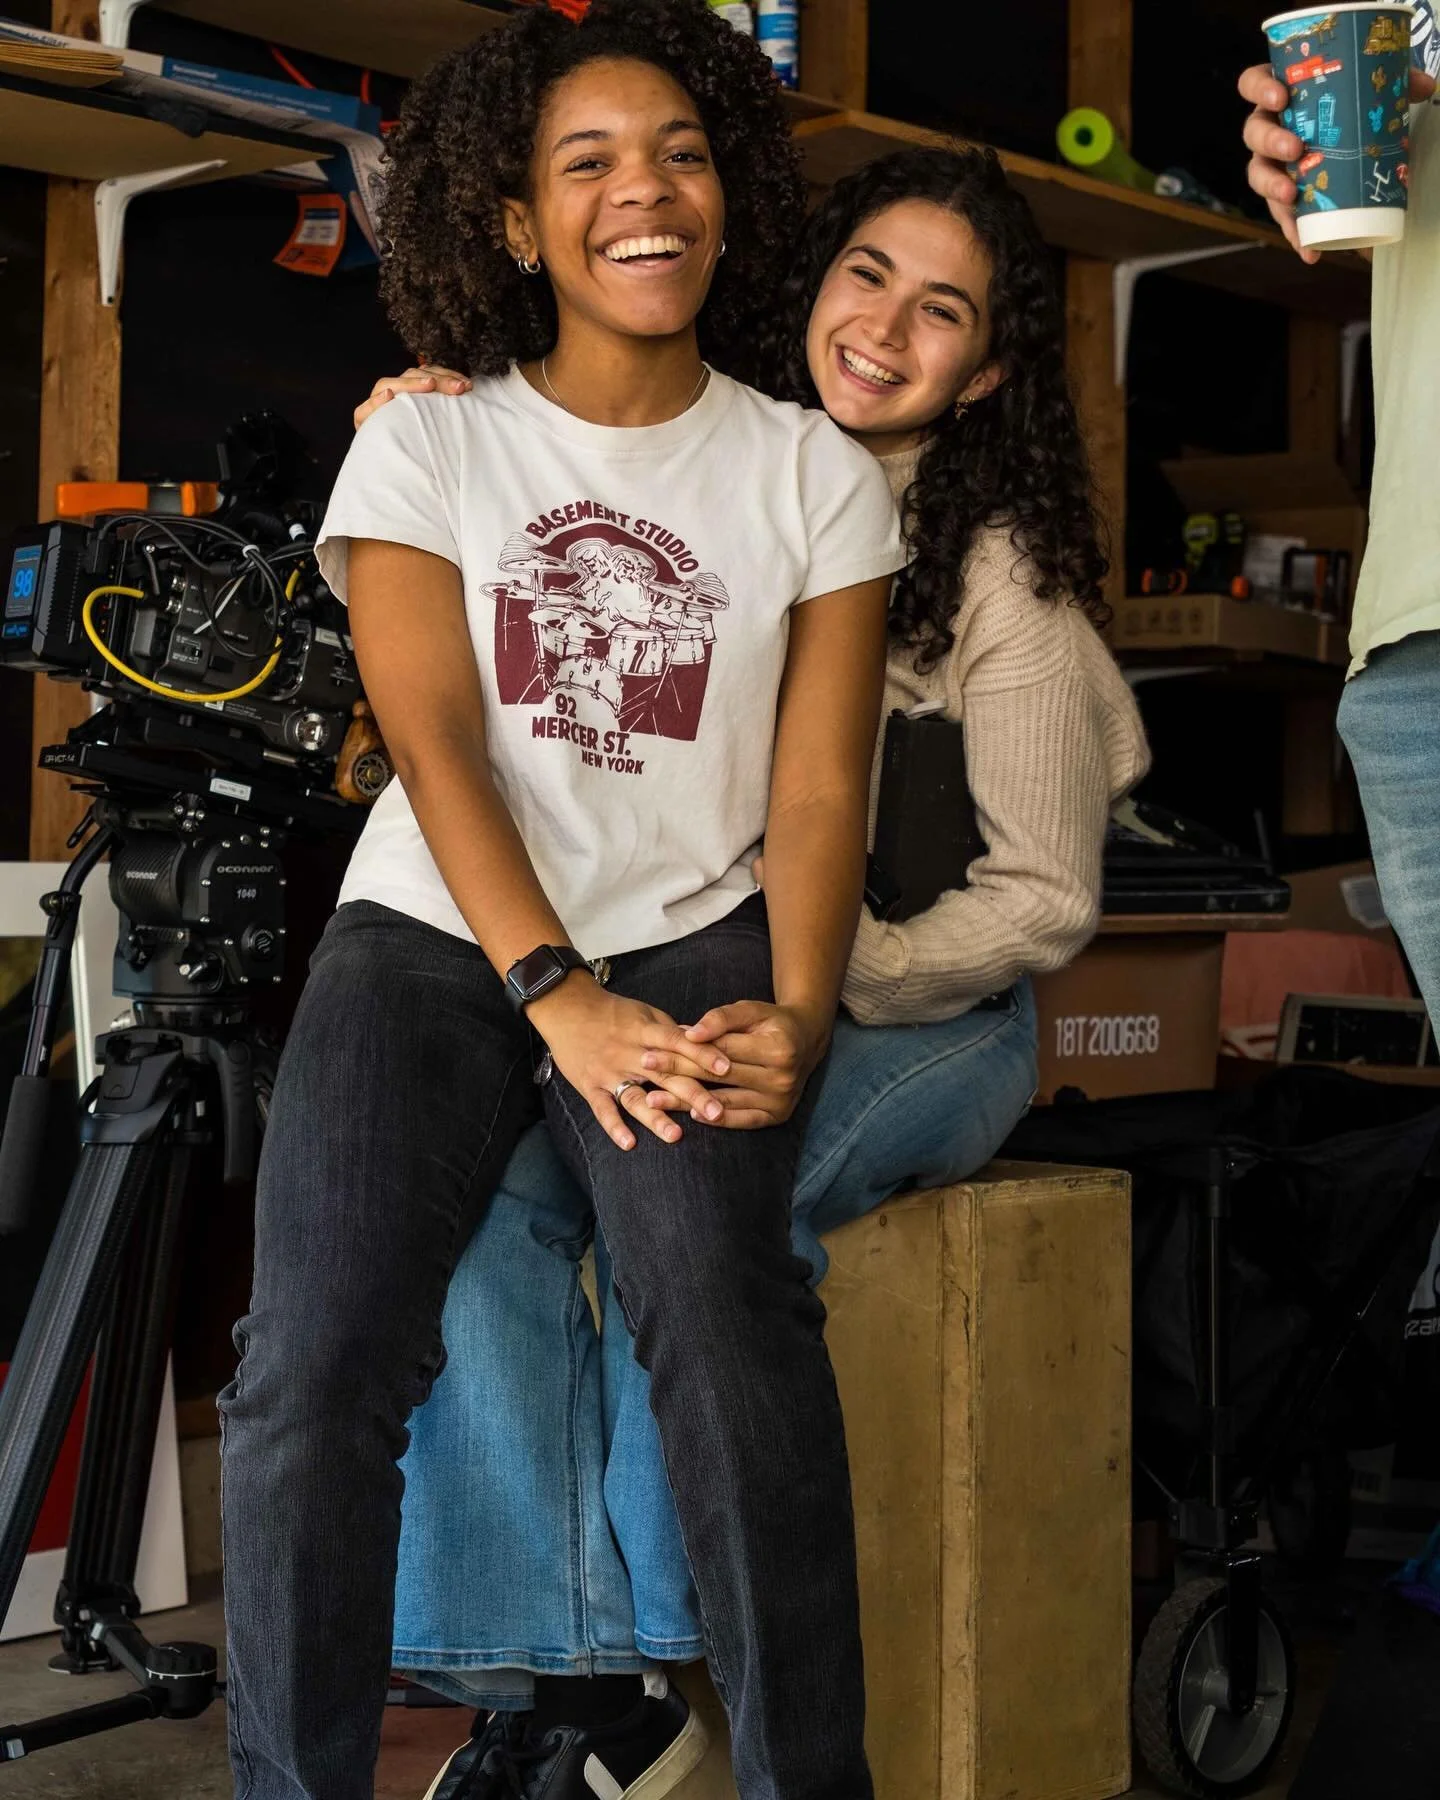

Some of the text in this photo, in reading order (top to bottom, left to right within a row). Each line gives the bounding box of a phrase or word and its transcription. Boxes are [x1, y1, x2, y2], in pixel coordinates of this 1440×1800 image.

[526, 500, 700, 573] BASEMENT STUDIO
[14, 569, 34, 598] 98
[555, 693, 577, 718] 92
[532, 717, 631, 756] MERCER ST.
[581, 749, 645, 775] NEW YORK
